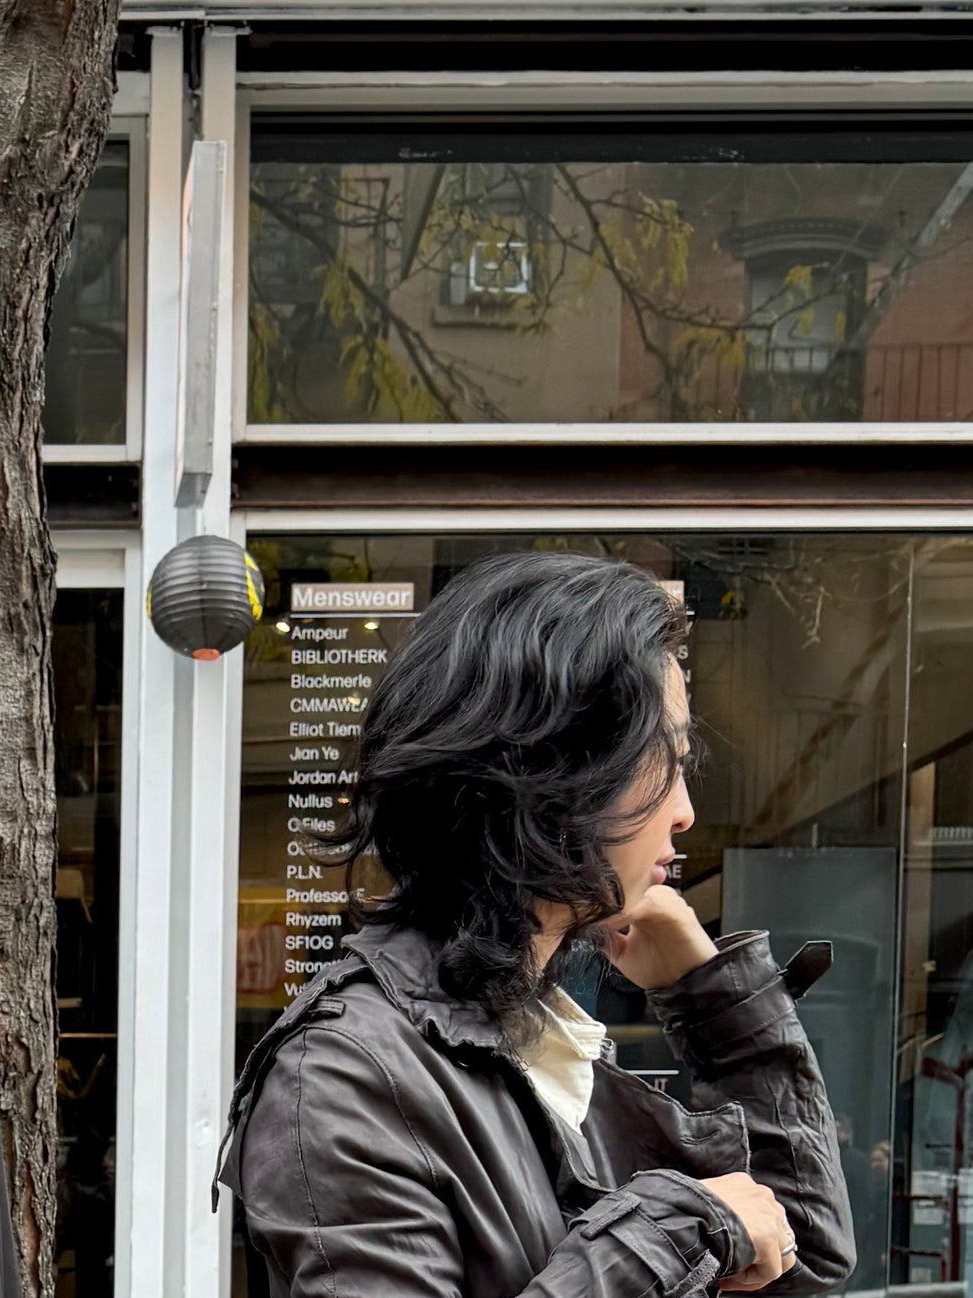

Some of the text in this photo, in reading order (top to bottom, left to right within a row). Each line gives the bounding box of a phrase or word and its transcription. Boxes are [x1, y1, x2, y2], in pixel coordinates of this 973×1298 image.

[293, 586, 411, 607] Menswear
[291, 650, 387, 664] BIBLIOTHERK
[291, 674, 372, 689] Blackmerle
[290, 722, 323, 737] Elliot
[290, 746, 339, 760] Jian Ye
[288, 770, 336, 784] Jordan
[287, 888, 350, 903] Professo
[286, 912, 342, 928] Rhyzem
